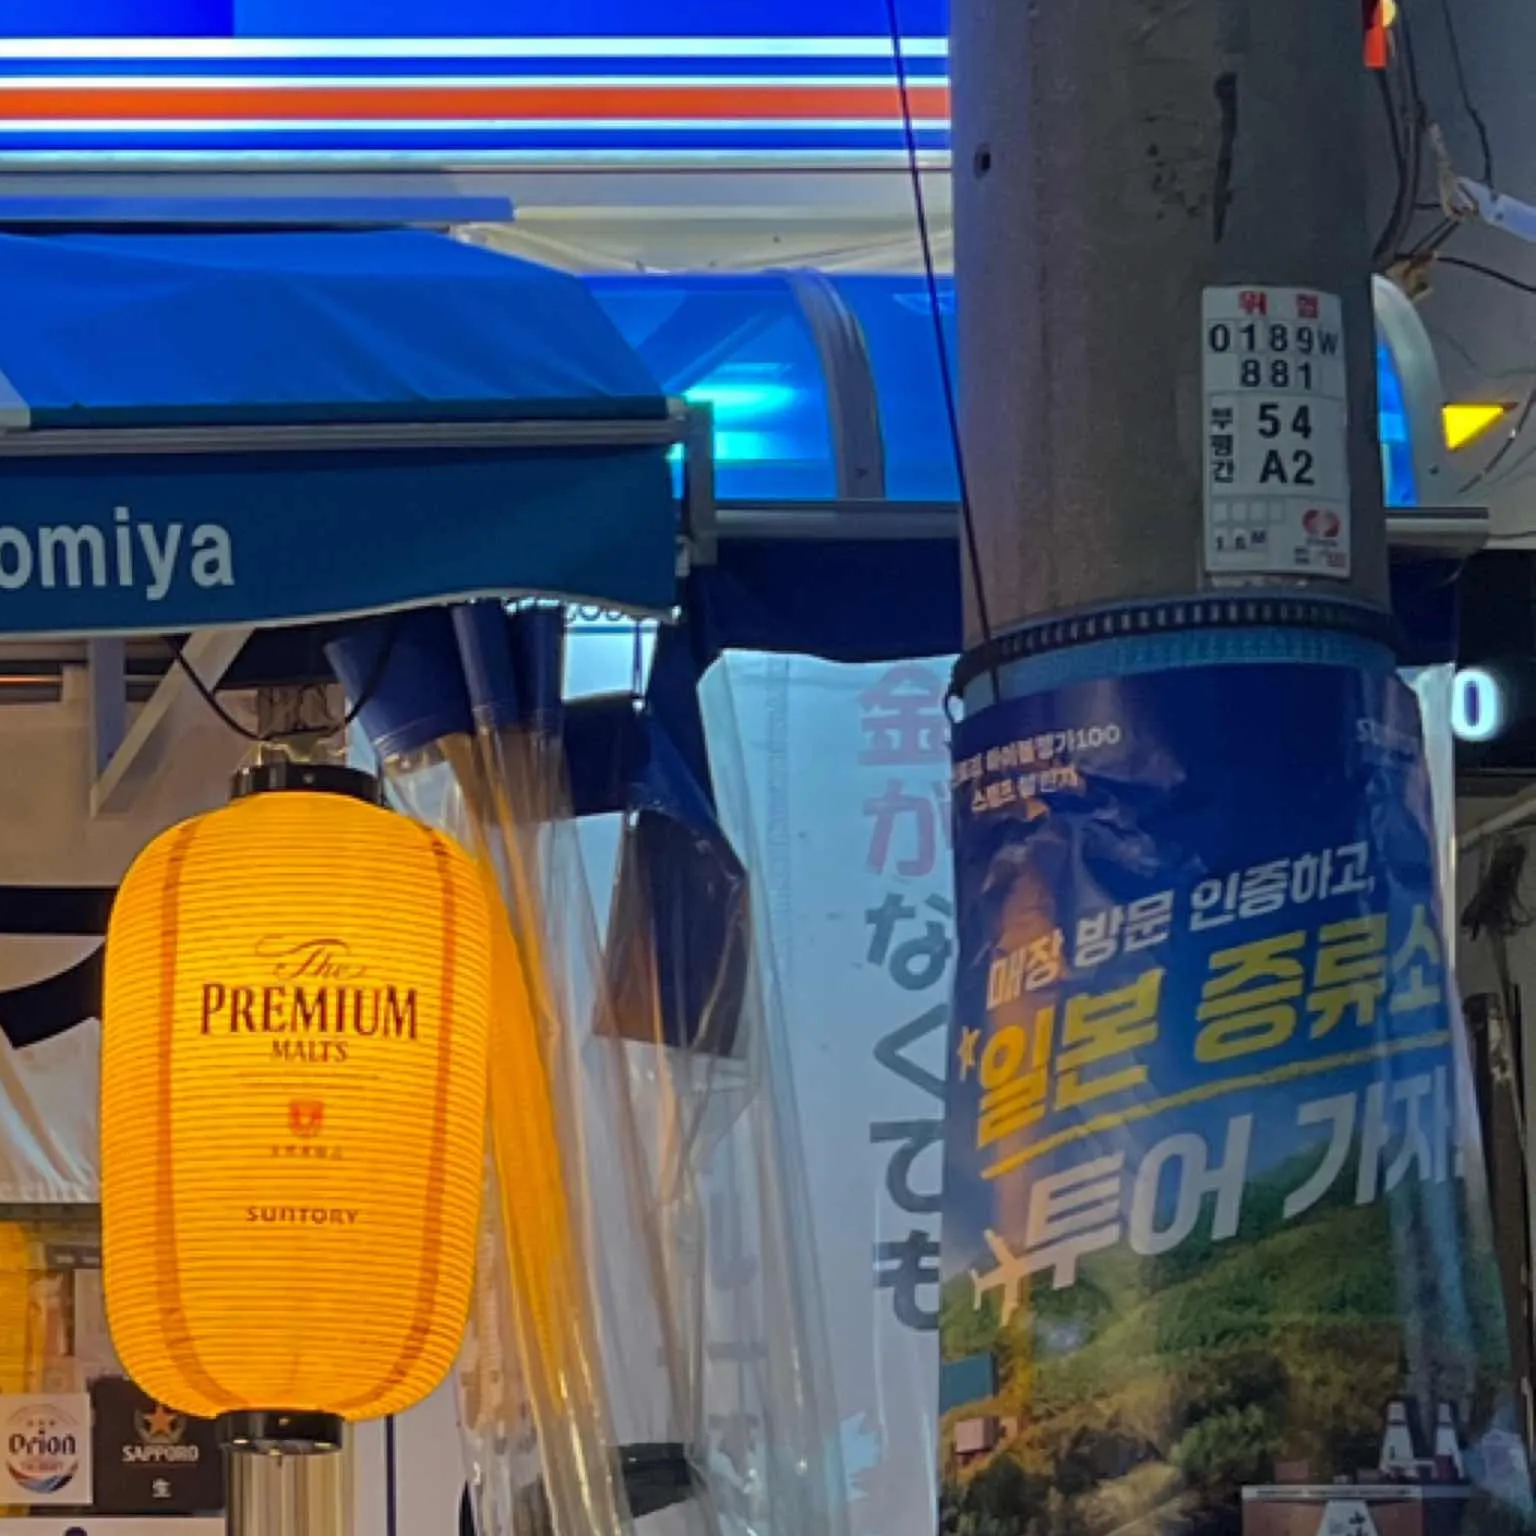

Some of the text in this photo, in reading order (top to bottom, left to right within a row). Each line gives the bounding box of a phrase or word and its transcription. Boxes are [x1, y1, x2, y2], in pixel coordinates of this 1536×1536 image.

[1209, 323, 1338, 355] 0189W
[1240, 359, 1312, 391] 881
[1257, 403, 1312, 439] 54
[1258, 449, 1315, 486] A2
[987, 840, 1376, 1012] 매장 방문 인증하고,
[200, 983, 419, 1041] PREMIUM
[977, 902, 1442, 1149] 일본 증류소
[272, 1040, 348, 1063] MALTS
[1020, 1114, 1256, 1292] 투어
[8, 1429, 77, 1456] Orion
[122, 1445, 199, 1463] SAPPORO
